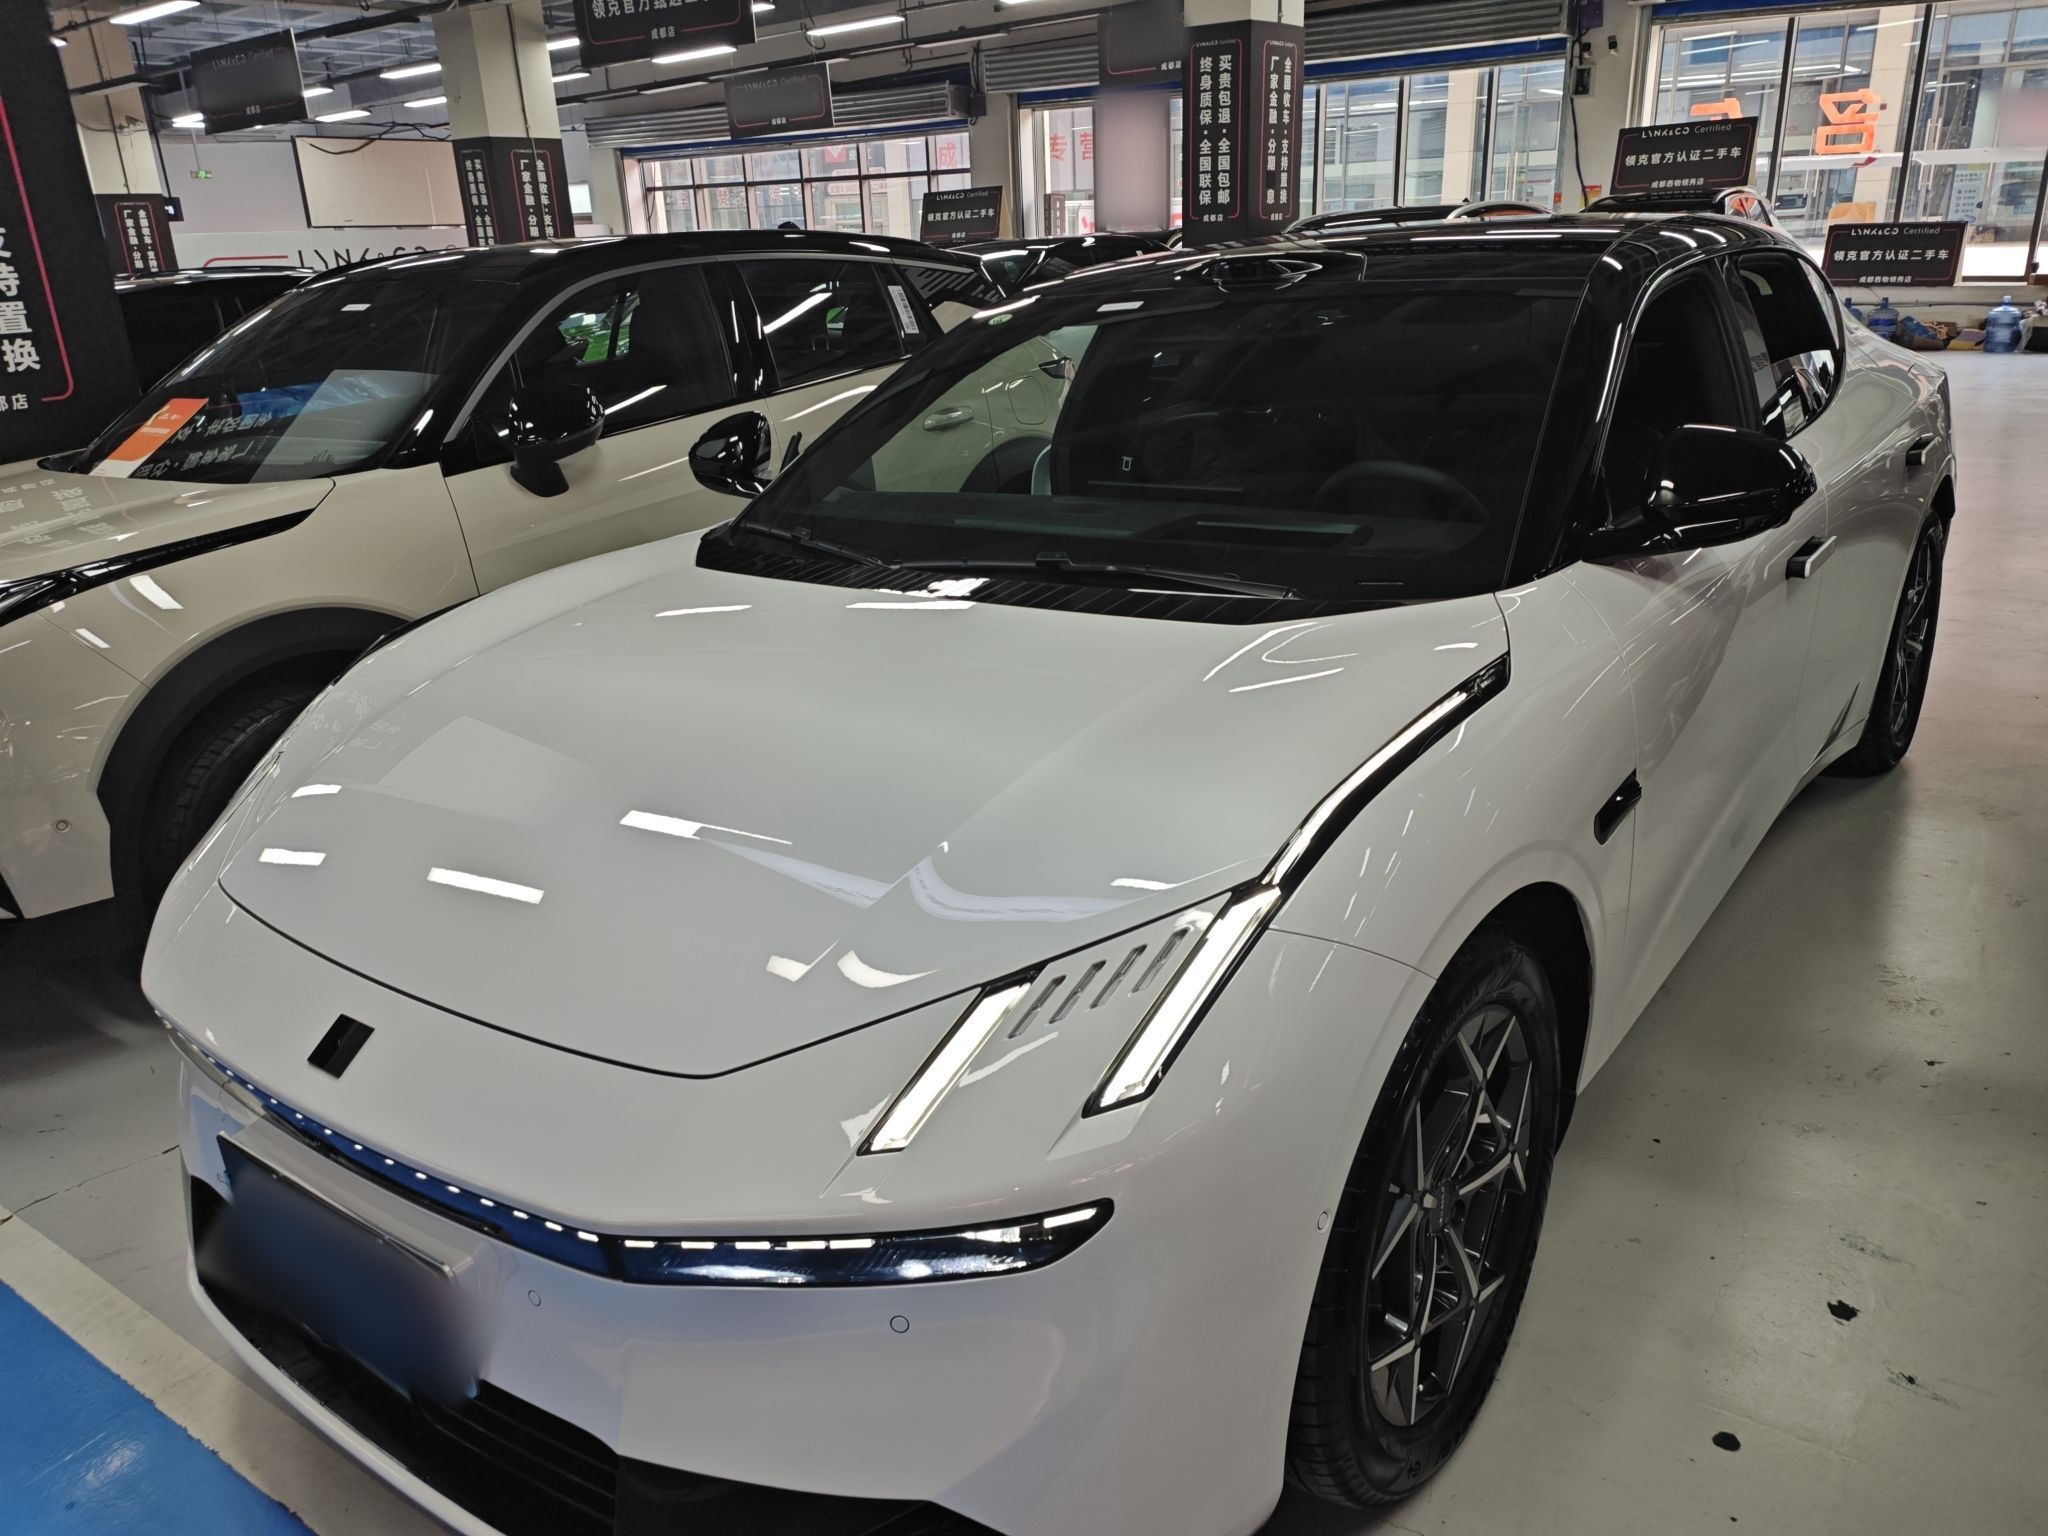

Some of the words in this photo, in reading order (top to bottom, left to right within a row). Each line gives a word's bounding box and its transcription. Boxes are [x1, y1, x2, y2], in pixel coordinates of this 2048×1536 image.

[1198, 57, 1213, 205] 终身质保·全国联保
[1266, 56, 1280, 204] 厂家金融·分期息
[1642, 126, 1690, 138] LYNK&CO
[1694, 123, 1732, 133] Certified
[1624, 147, 1742, 167] 领克官方认证二手车
[927, 208, 995, 222] 领克官方认证二手车
[1851, 227, 1899, 236] LYNK&CO
[1903, 226, 1940, 235] Certified
[1833, 250, 1949, 261] 领克官方认证二手车
